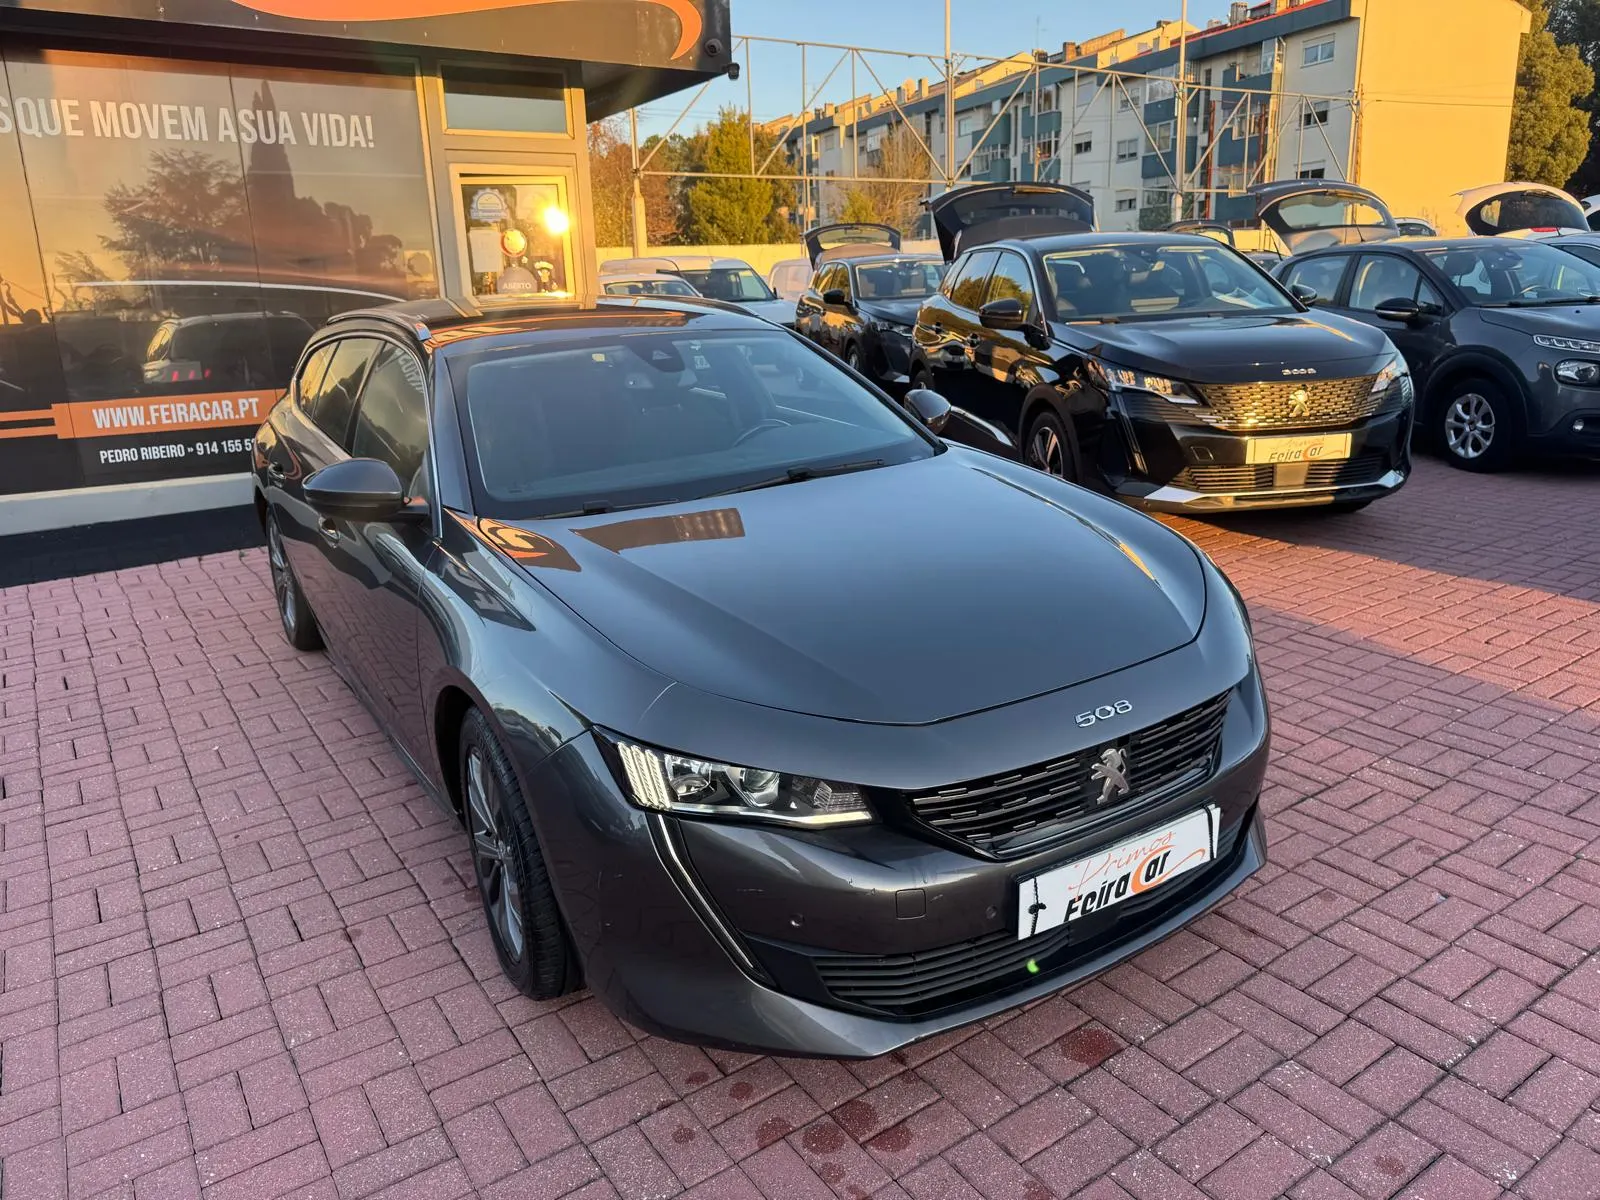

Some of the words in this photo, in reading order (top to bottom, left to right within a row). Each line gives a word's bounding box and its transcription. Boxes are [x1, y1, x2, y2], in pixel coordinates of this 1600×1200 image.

[89, 100, 209, 142] MOVEM
[301, 111, 375, 148] VIDA!
[92, 397, 259, 429] WWW.FEIRACAR.PT
[100, 447, 139, 464] PEDRO
[141, 443, 185, 461] RIBEIRO
[196, 441, 219, 456] 914
[221, 438, 243, 454] 155
[1074, 699, 1133, 728] 508
[1068, 831, 1176, 901] Primos
